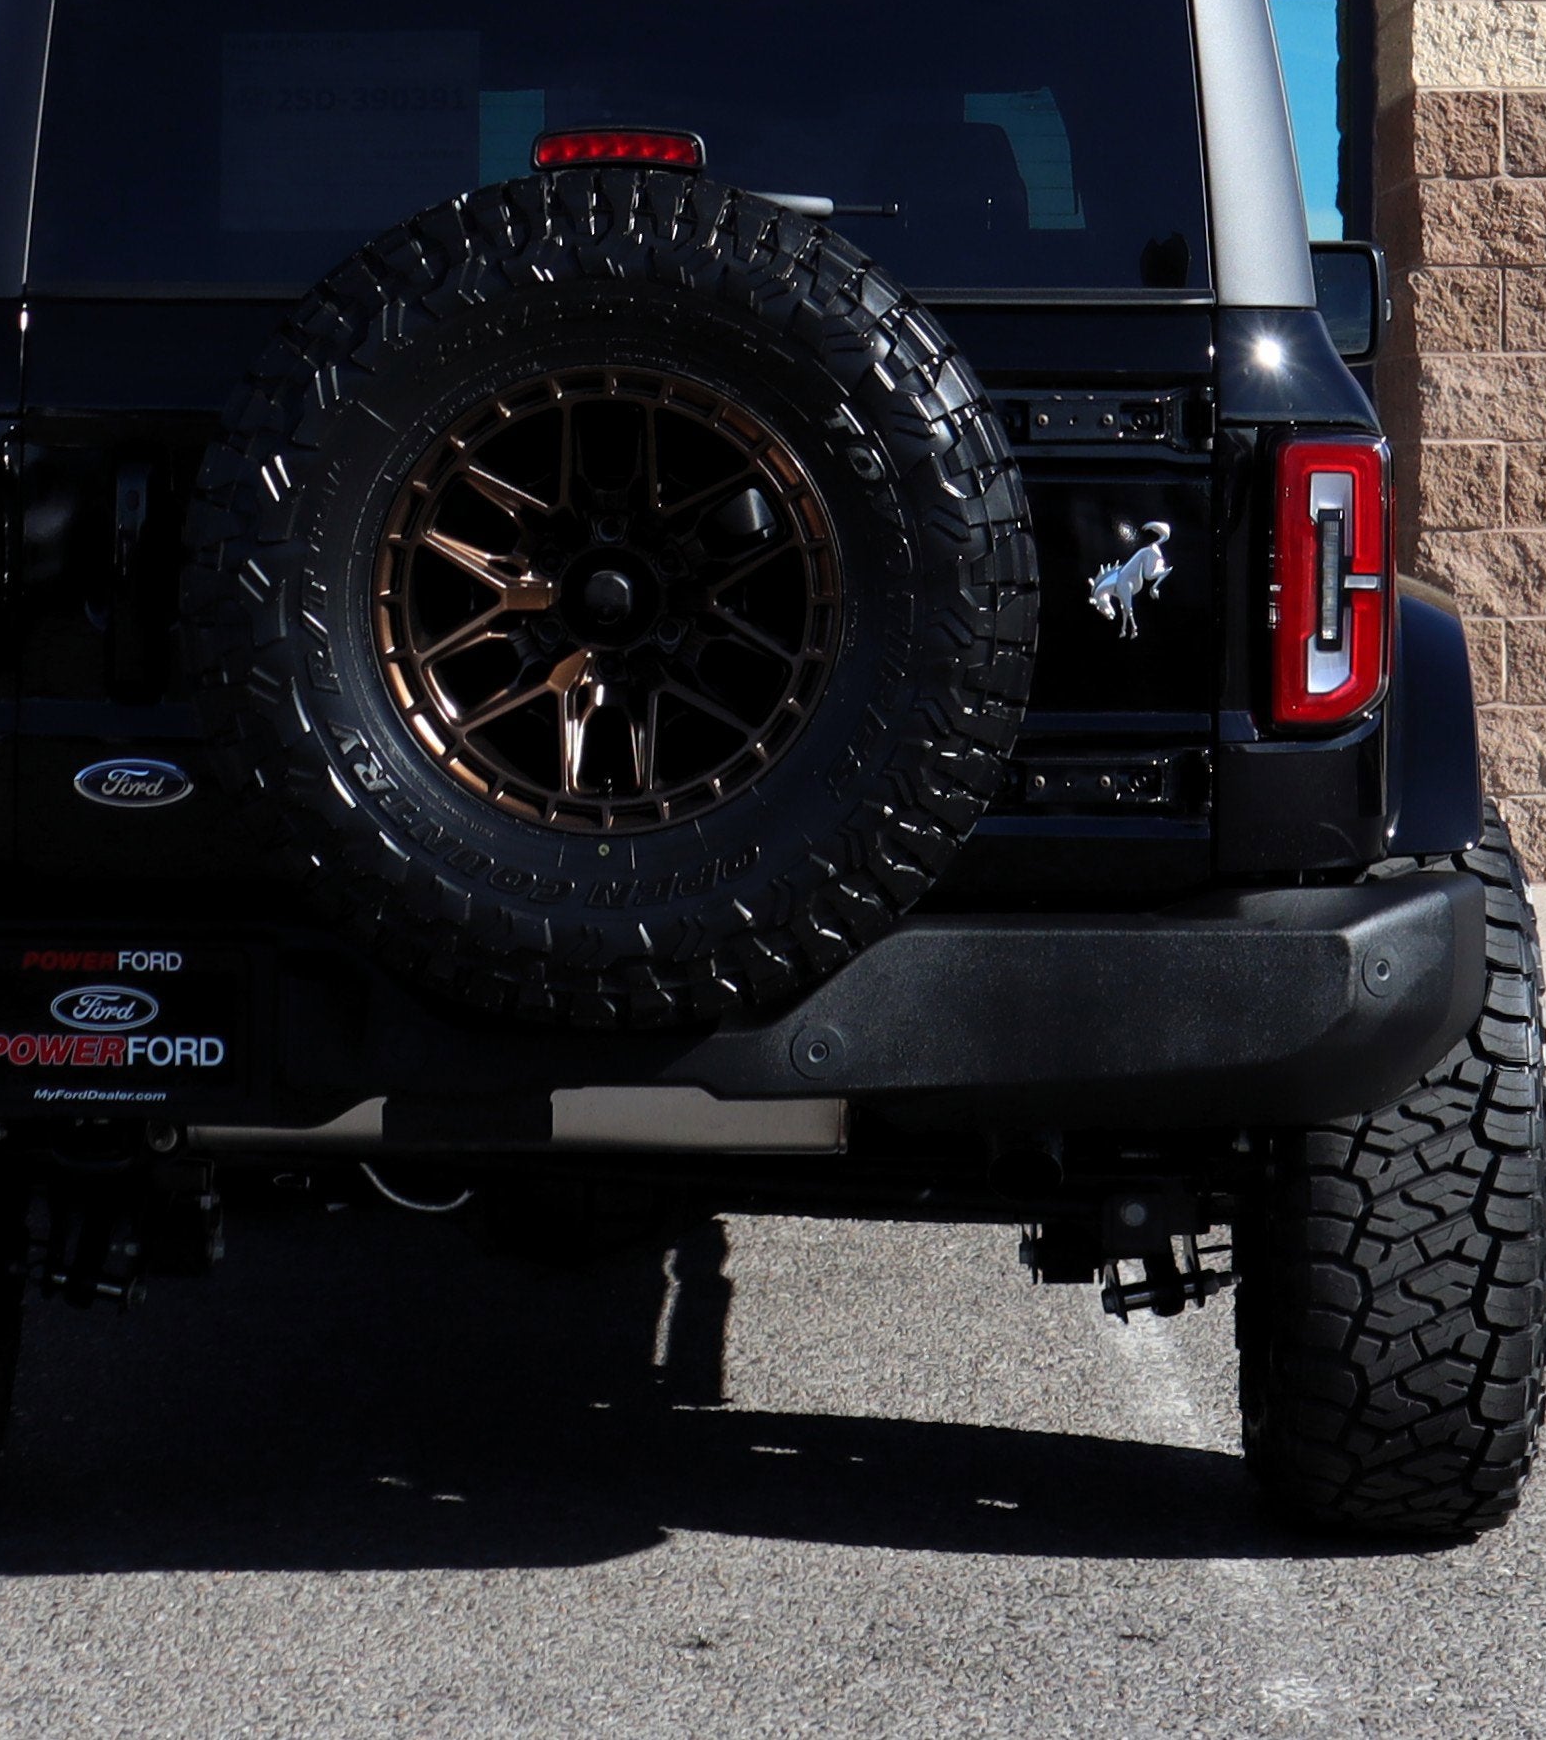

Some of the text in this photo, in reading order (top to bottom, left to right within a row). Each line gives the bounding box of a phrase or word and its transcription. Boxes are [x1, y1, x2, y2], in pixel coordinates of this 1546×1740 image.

[101, 768, 165, 796] Ford
[327, 716, 577, 905] COUNTRY
[21, 950, 183, 972] POWERFORD
[72, 993, 137, 1021] Ford
[33, 1088, 167, 1102] MyFordDealer.com
